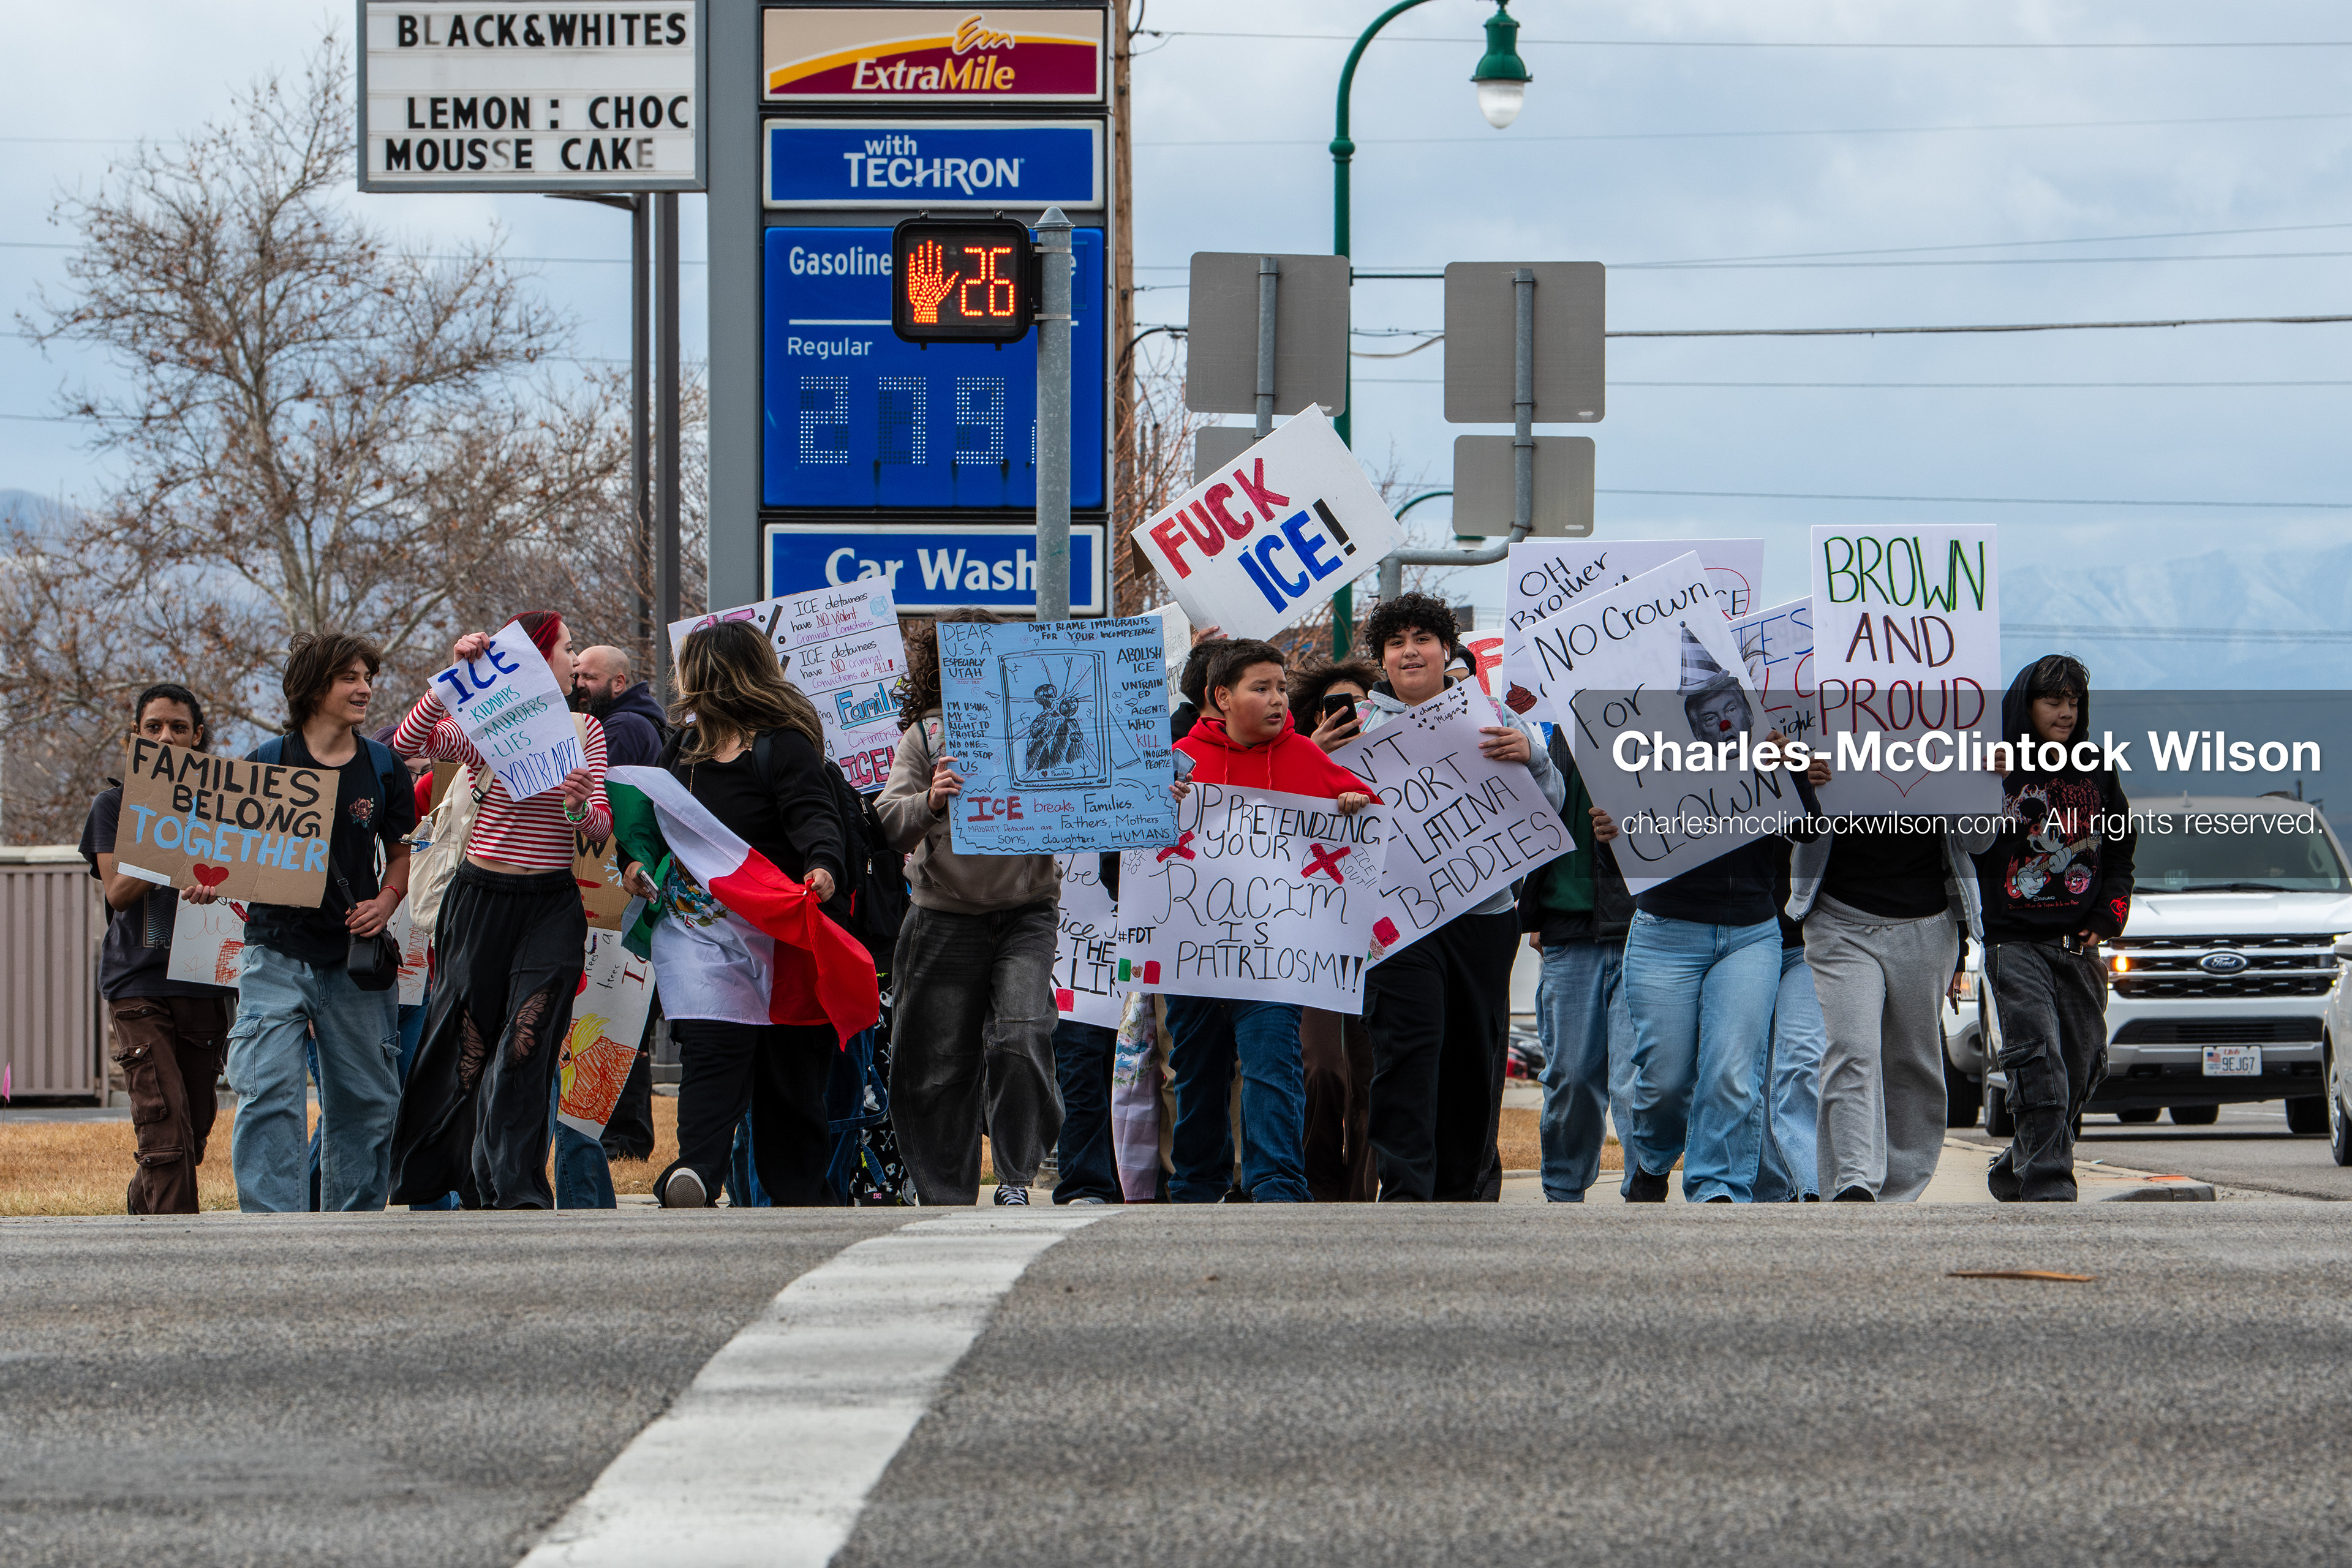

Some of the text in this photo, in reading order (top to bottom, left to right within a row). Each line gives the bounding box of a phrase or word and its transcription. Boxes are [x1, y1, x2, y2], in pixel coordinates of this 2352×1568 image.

[398, 13, 686, 47] BLACK&WHITES
[852, 56, 1015, 91] ExtraMile
[407, 97, 530, 129] LEMON
[589, 96, 688, 128] CHOC
[386, 138, 654, 170] MOUSSE CAKE
[865, 135, 917, 155] with
[789, 246, 892, 276] Gasoline
[960, 247, 1014, 317] 26
[788, 337, 872, 359] Regular
[1149, 458, 1290, 579] FUCK
[825, 548, 1037, 590] Car Wash
[1237, 498, 1357, 616] ICE!
[1520, 557, 1570, 597] OH
[1823, 535, 1985, 612] BROWN
[794, 593, 868, 617] ICE detainees
[1602, 582, 1711, 640] Crown
[790, 621, 812, 632] have
[816, 612, 832, 627] NO
[796, 620, 873, 644] Criminal Convictions
[943, 624, 993, 641] DEAR
[1028, 617, 1150, 632] DONT BLAME IMMIGRANTS
[1042, 631, 1058, 640] FOR
[1067, 631, 1095, 640] YOUR
[1845, 612, 1954, 668] AND
[799, 646, 825, 666] ICE
[832, 641, 876, 658] detainees
[1117, 646, 1162, 664] ABOLISH
[437, 641, 520, 705] ICE
[799, 668, 823, 679] have
[831, 658, 846, 674] NO
[812, 673, 858, 688] Convictions
[861, 669, 869, 678] at
[949, 668, 982, 678] UTAH
[1121, 678, 1163, 691] UNTRAIN
[1138, 690, 1150, 699] ED
[470, 684, 520, 723] KIDNAPS
[947, 701, 988, 711] I'M USING
[1131, 705, 1167, 715] AGENTS
[1434, 707, 1461, 724] Migra
[1819, 677, 1986, 736] PROUD
[484, 696, 548, 741] MURDERS
[947, 712, 962, 722] MY
[1128, 718, 1155, 731] WHO
[494, 731, 531, 757] LIES
[949, 740, 962, 749] NO
[950, 730, 987, 739] PROTEST
[1136, 733, 1161, 748] KILL
[499, 736, 579, 797] YOU'RE NEXT
[973, 750, 993, 760] STOP
[1145, 759, 1171, 770] PEOPLE
[133, 738, 320, 807] FAMILIES
[172, 784, 321, 837] BELONG
[967, 796, 1023, 822] ICE
[1034, 797, 1074, 814] breaks
[1116, 815, 1159, 827] Mothers
[1227, 794, 1381, 845] PRETENDING
[1405, 775, 1520, 864] LATINA
[1628, 766, 1782, 862] CLOWN
[129, 804, 328, 873] TOGETHER
[1398, 812, 1562, 930] BADDIES
[1118, 926, 1156, 944] #FDT
[1216, 921, 1268, 945] IS
[2212, 957, 2236, 967] Ford
